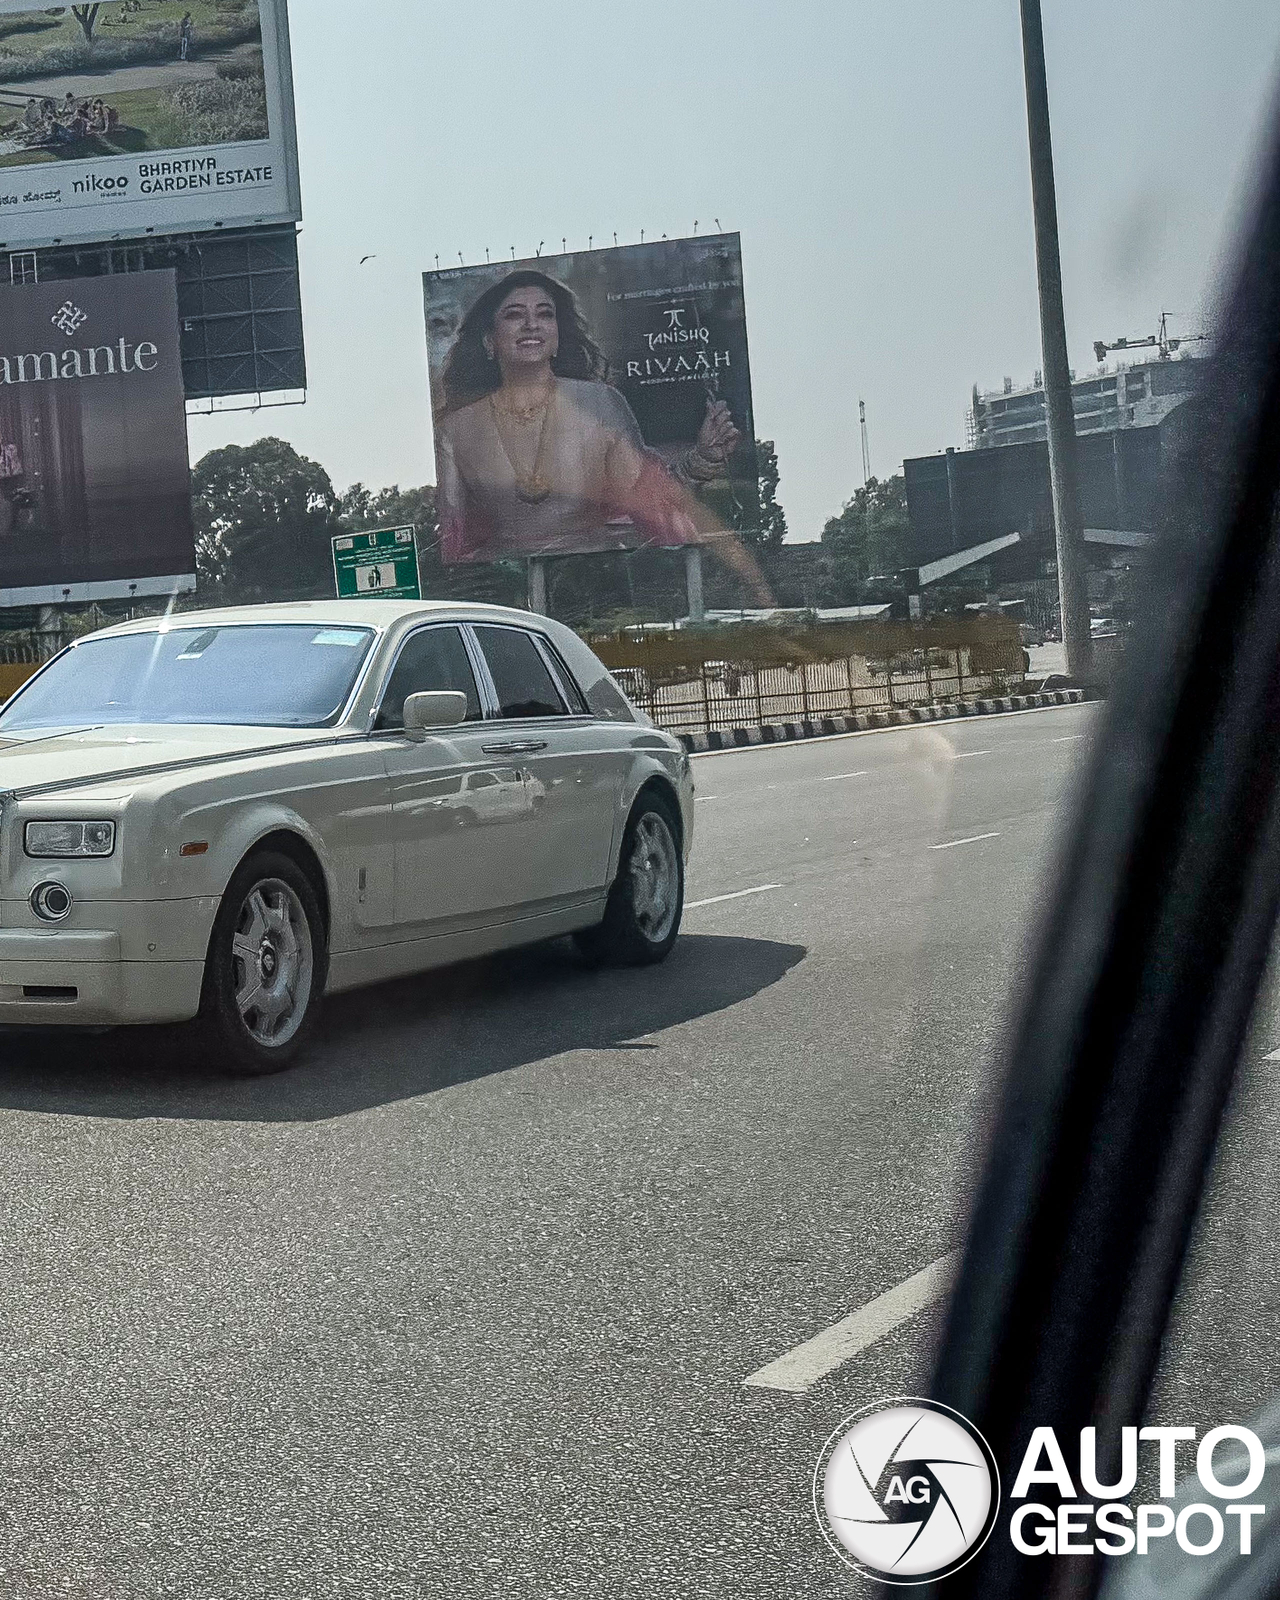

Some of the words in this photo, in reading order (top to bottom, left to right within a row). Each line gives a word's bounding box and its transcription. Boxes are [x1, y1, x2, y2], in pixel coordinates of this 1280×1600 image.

[139, 157, 217, 177] BHARTIYA
[72, 174, 129, 193] nikoo
[140, 174, 211, 194] GARDEN
[216, 166, 273, 185] ESTATE
